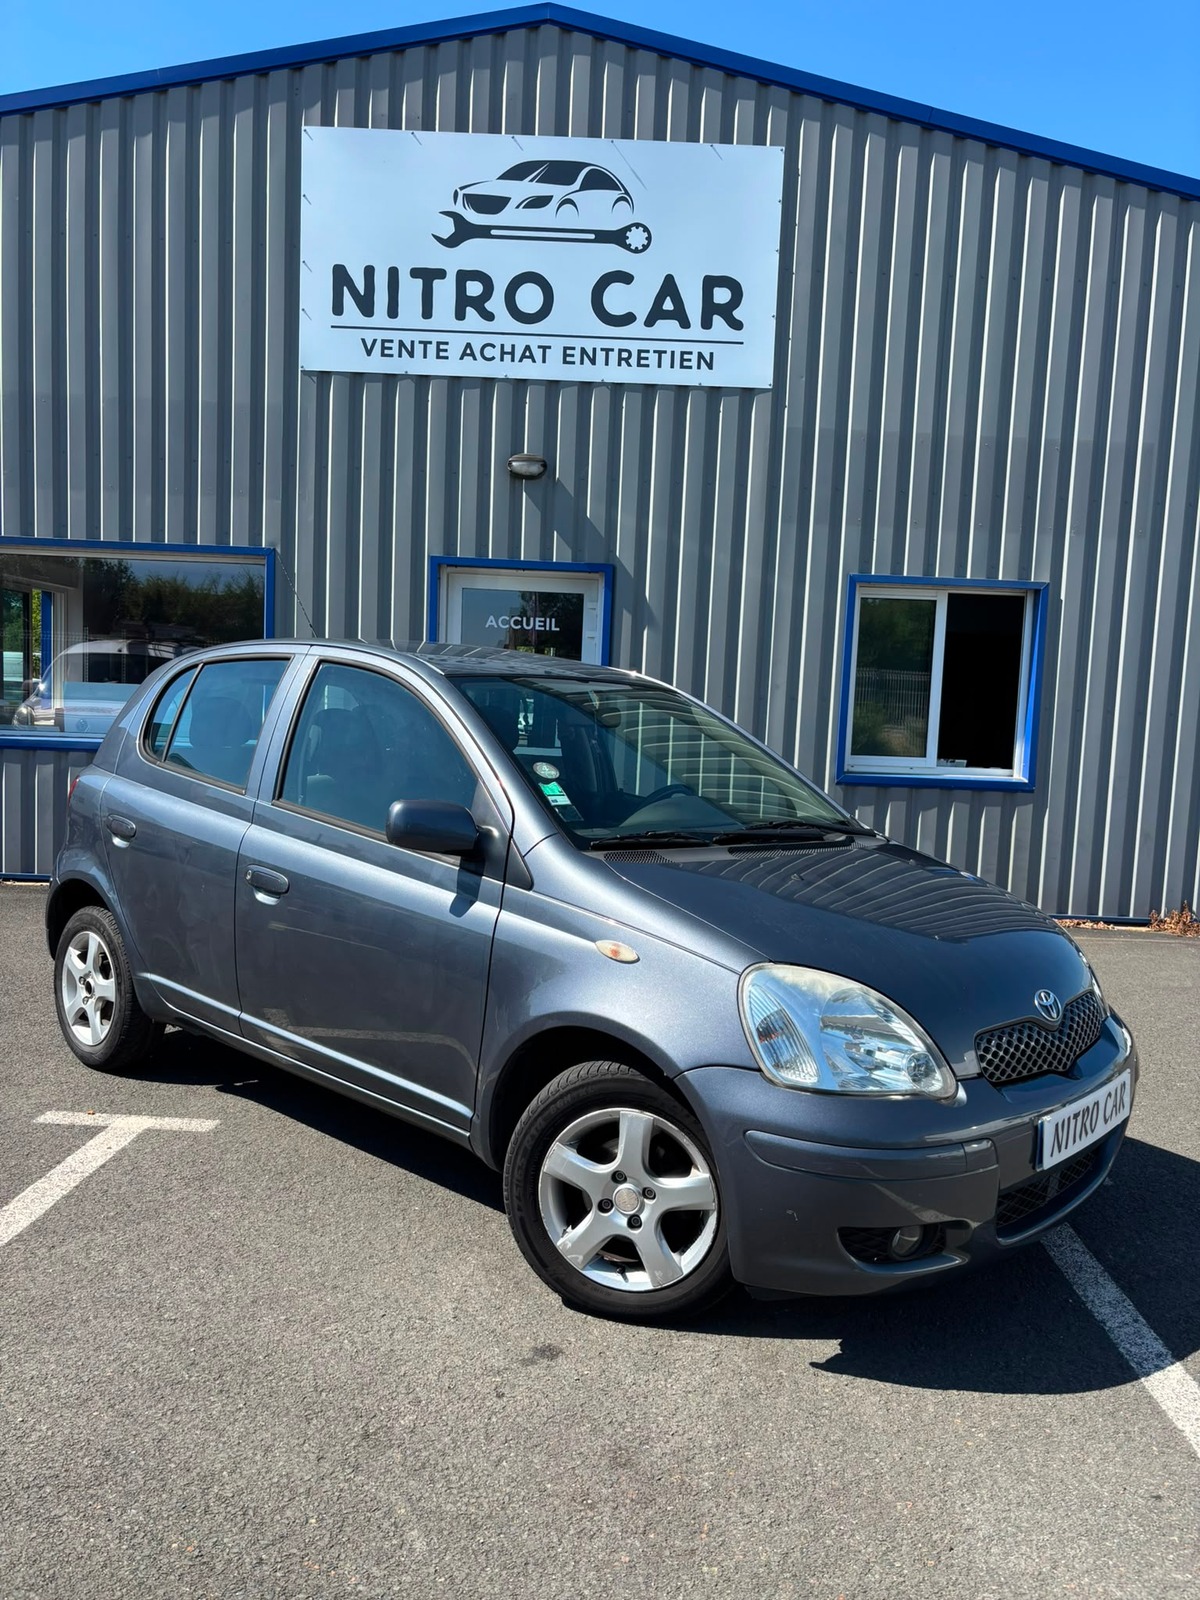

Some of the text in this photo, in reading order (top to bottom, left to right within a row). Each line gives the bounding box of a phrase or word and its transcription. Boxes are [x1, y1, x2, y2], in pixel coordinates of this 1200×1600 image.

[331, 263, 744, 332] NITRO CAR
[360, 337, 714, 371] VENTE ACHAT ENTRETIEN
[485, 614, 560, 632] ACCUEIL
[1049, 1080, 1126, 1158] NITRO CAR
